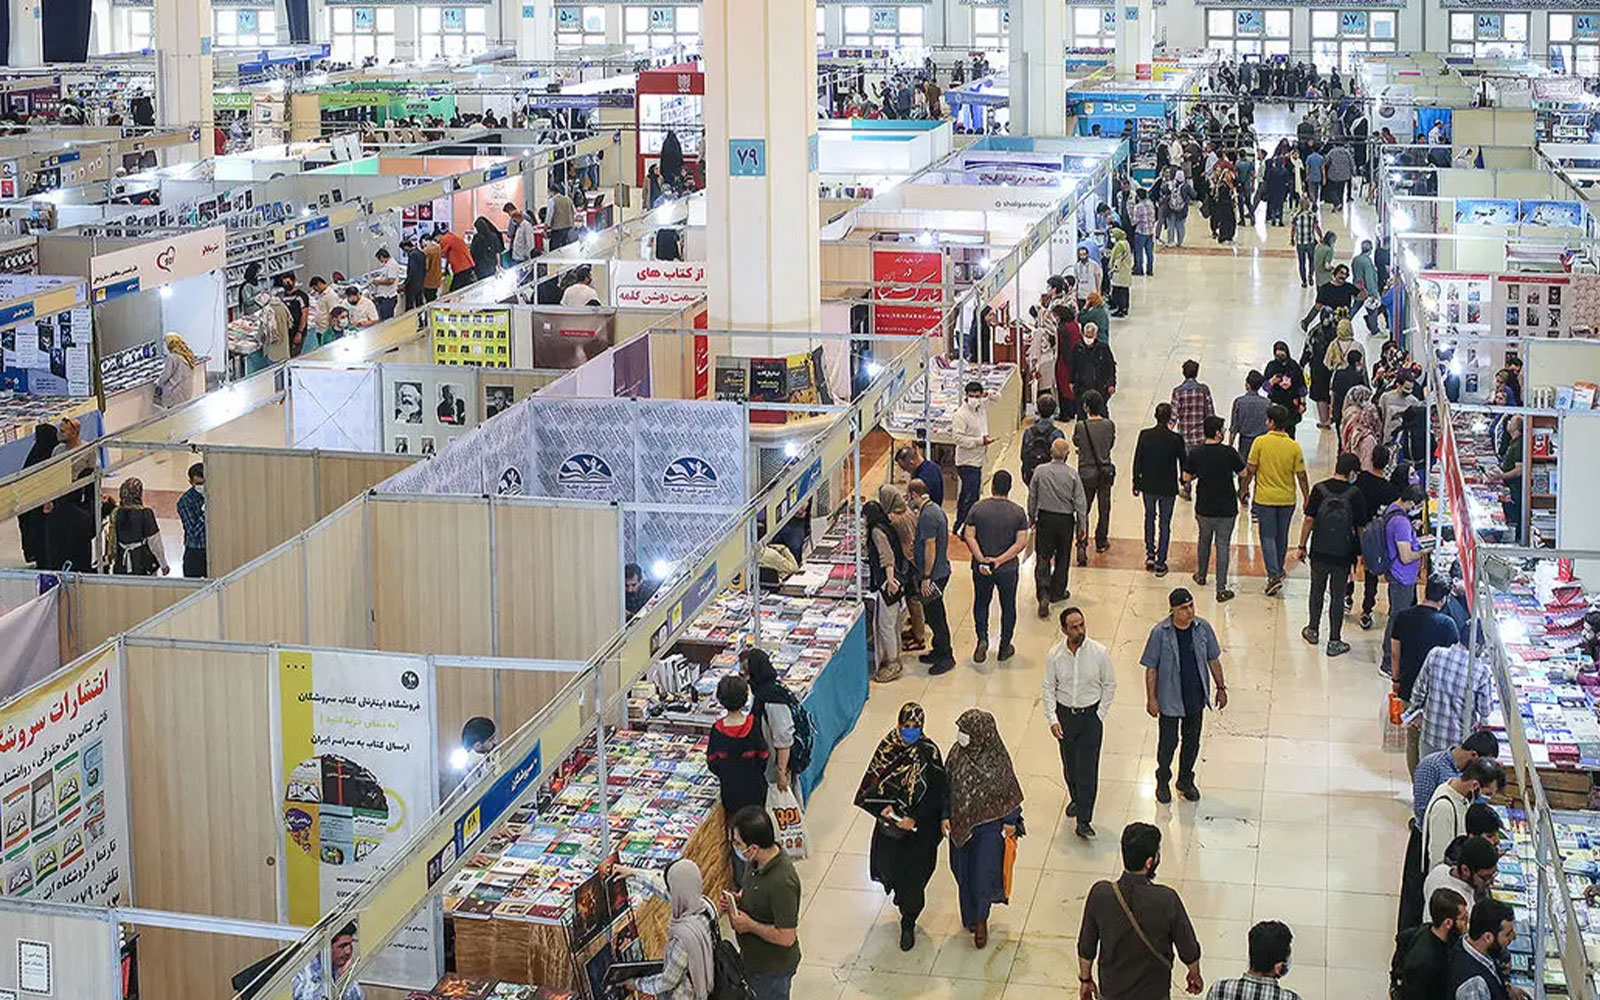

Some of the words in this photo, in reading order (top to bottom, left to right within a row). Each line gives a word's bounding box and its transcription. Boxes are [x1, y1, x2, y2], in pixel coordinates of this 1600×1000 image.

[652, 10, 664, 21] ۵۱
[1238, 13, 1253, 25] ۵۶
[1342, 14, 1358, 26] ۵۷
[1479, 17, 1492, 27] ۵۸
[736, 147, 759, 167] ۷۹
[636, 266, 661, 281] های
[663, 266, 693, 281] کتاب
[619, 290, 641, 301] کلمه
[642, 290, 669, 305] روشن
[50, 667, 109, 723] انتشارات
[297, 692, 337, 705] سروشگان
[338, 694, 357, 705] کتاب
[358, 696, 388, 710] اینترنتی
[387, 699, 421, 712] فروشگاه
[78, 718, 94, 741] کتاب
[61, 732, 77, 751] های
[310, 735, 331, 745] ایران
[331, 737, 356, 747] سراسر
[356, 739, 365, 748] به
[366, 739, 385, 749] کتاب
[385, 742, 411, 753] ارسال
[56, 857, 90, 890] فروشگاه
